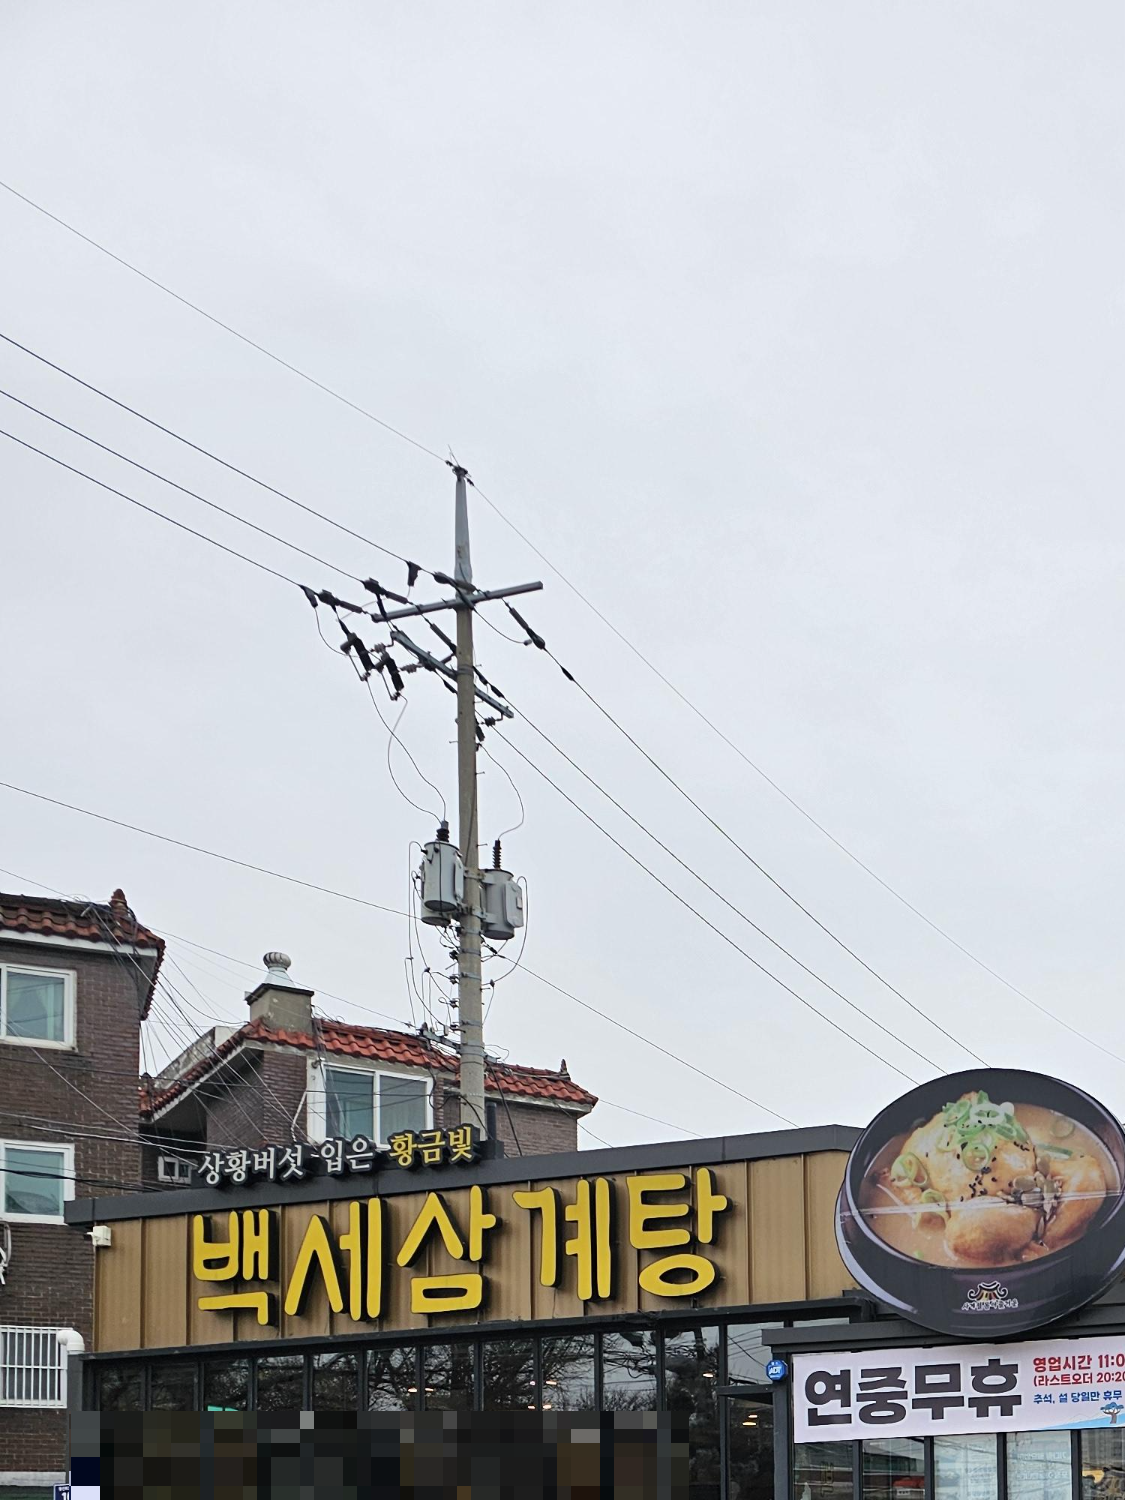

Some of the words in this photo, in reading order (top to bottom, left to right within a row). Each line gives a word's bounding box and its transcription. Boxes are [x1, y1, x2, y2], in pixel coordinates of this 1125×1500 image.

[197, 1144, 304, 1185] 상황버섯
[320, 1136, 374, 1173] 입은
[389, 1125, 472, 1167] 황금빛
[192, 1166, 729, 1326] 백세삼계탕
[1033, 1355, 1093, 1373] 영업시간
[1033, 1372, 1093, 1387] (라스트오더
[803, 1356, 1023, 1428] 연중무휴
[1033, 1393, 1055, 1405] 추석,
[1058, 1392, 1068, 1404] 설
[1070, 1391, 1100, 1403] 당일만
[1102, 1389, 1123, 1401] 휴무
